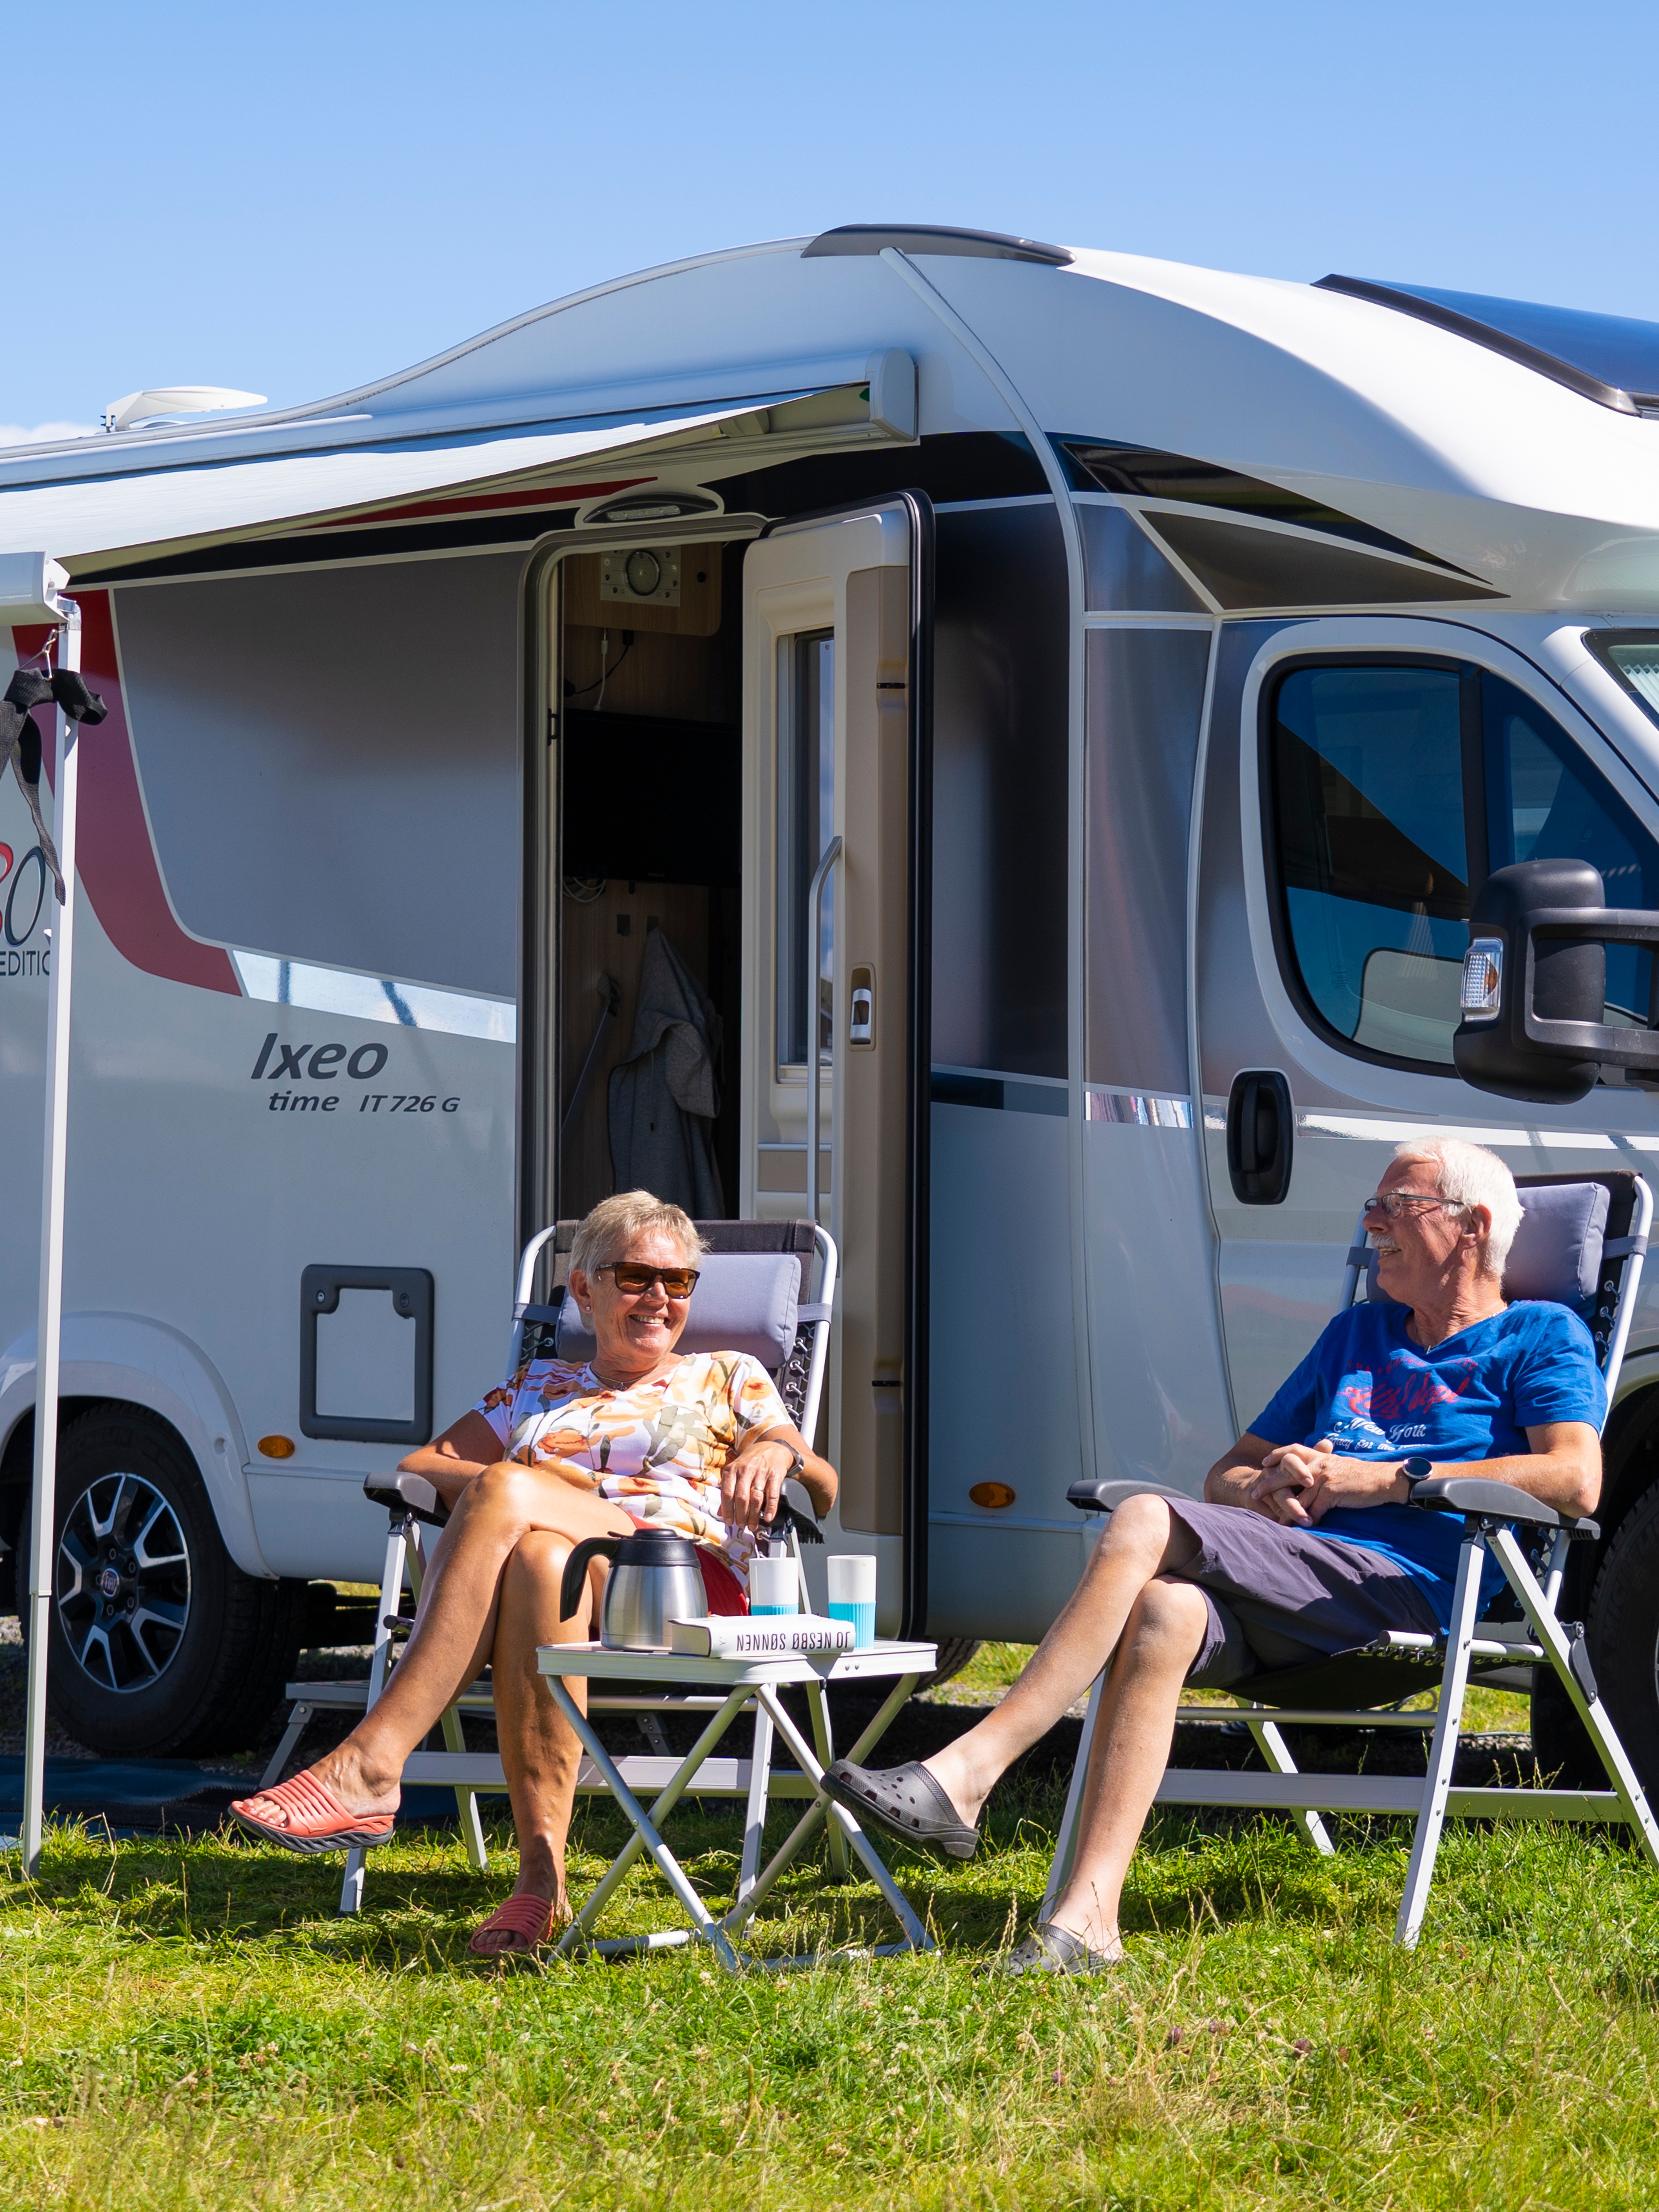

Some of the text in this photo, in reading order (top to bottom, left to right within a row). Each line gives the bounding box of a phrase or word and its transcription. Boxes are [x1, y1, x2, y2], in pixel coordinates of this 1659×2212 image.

[251, 1033, 388, 1079] Ixeo
[269, 1090, 461, 1112] time IT 726 G
[1386, 1423, 1426, 1444] York
[736, 1631, 851, 1651] JO NESBØ SØNNEN
